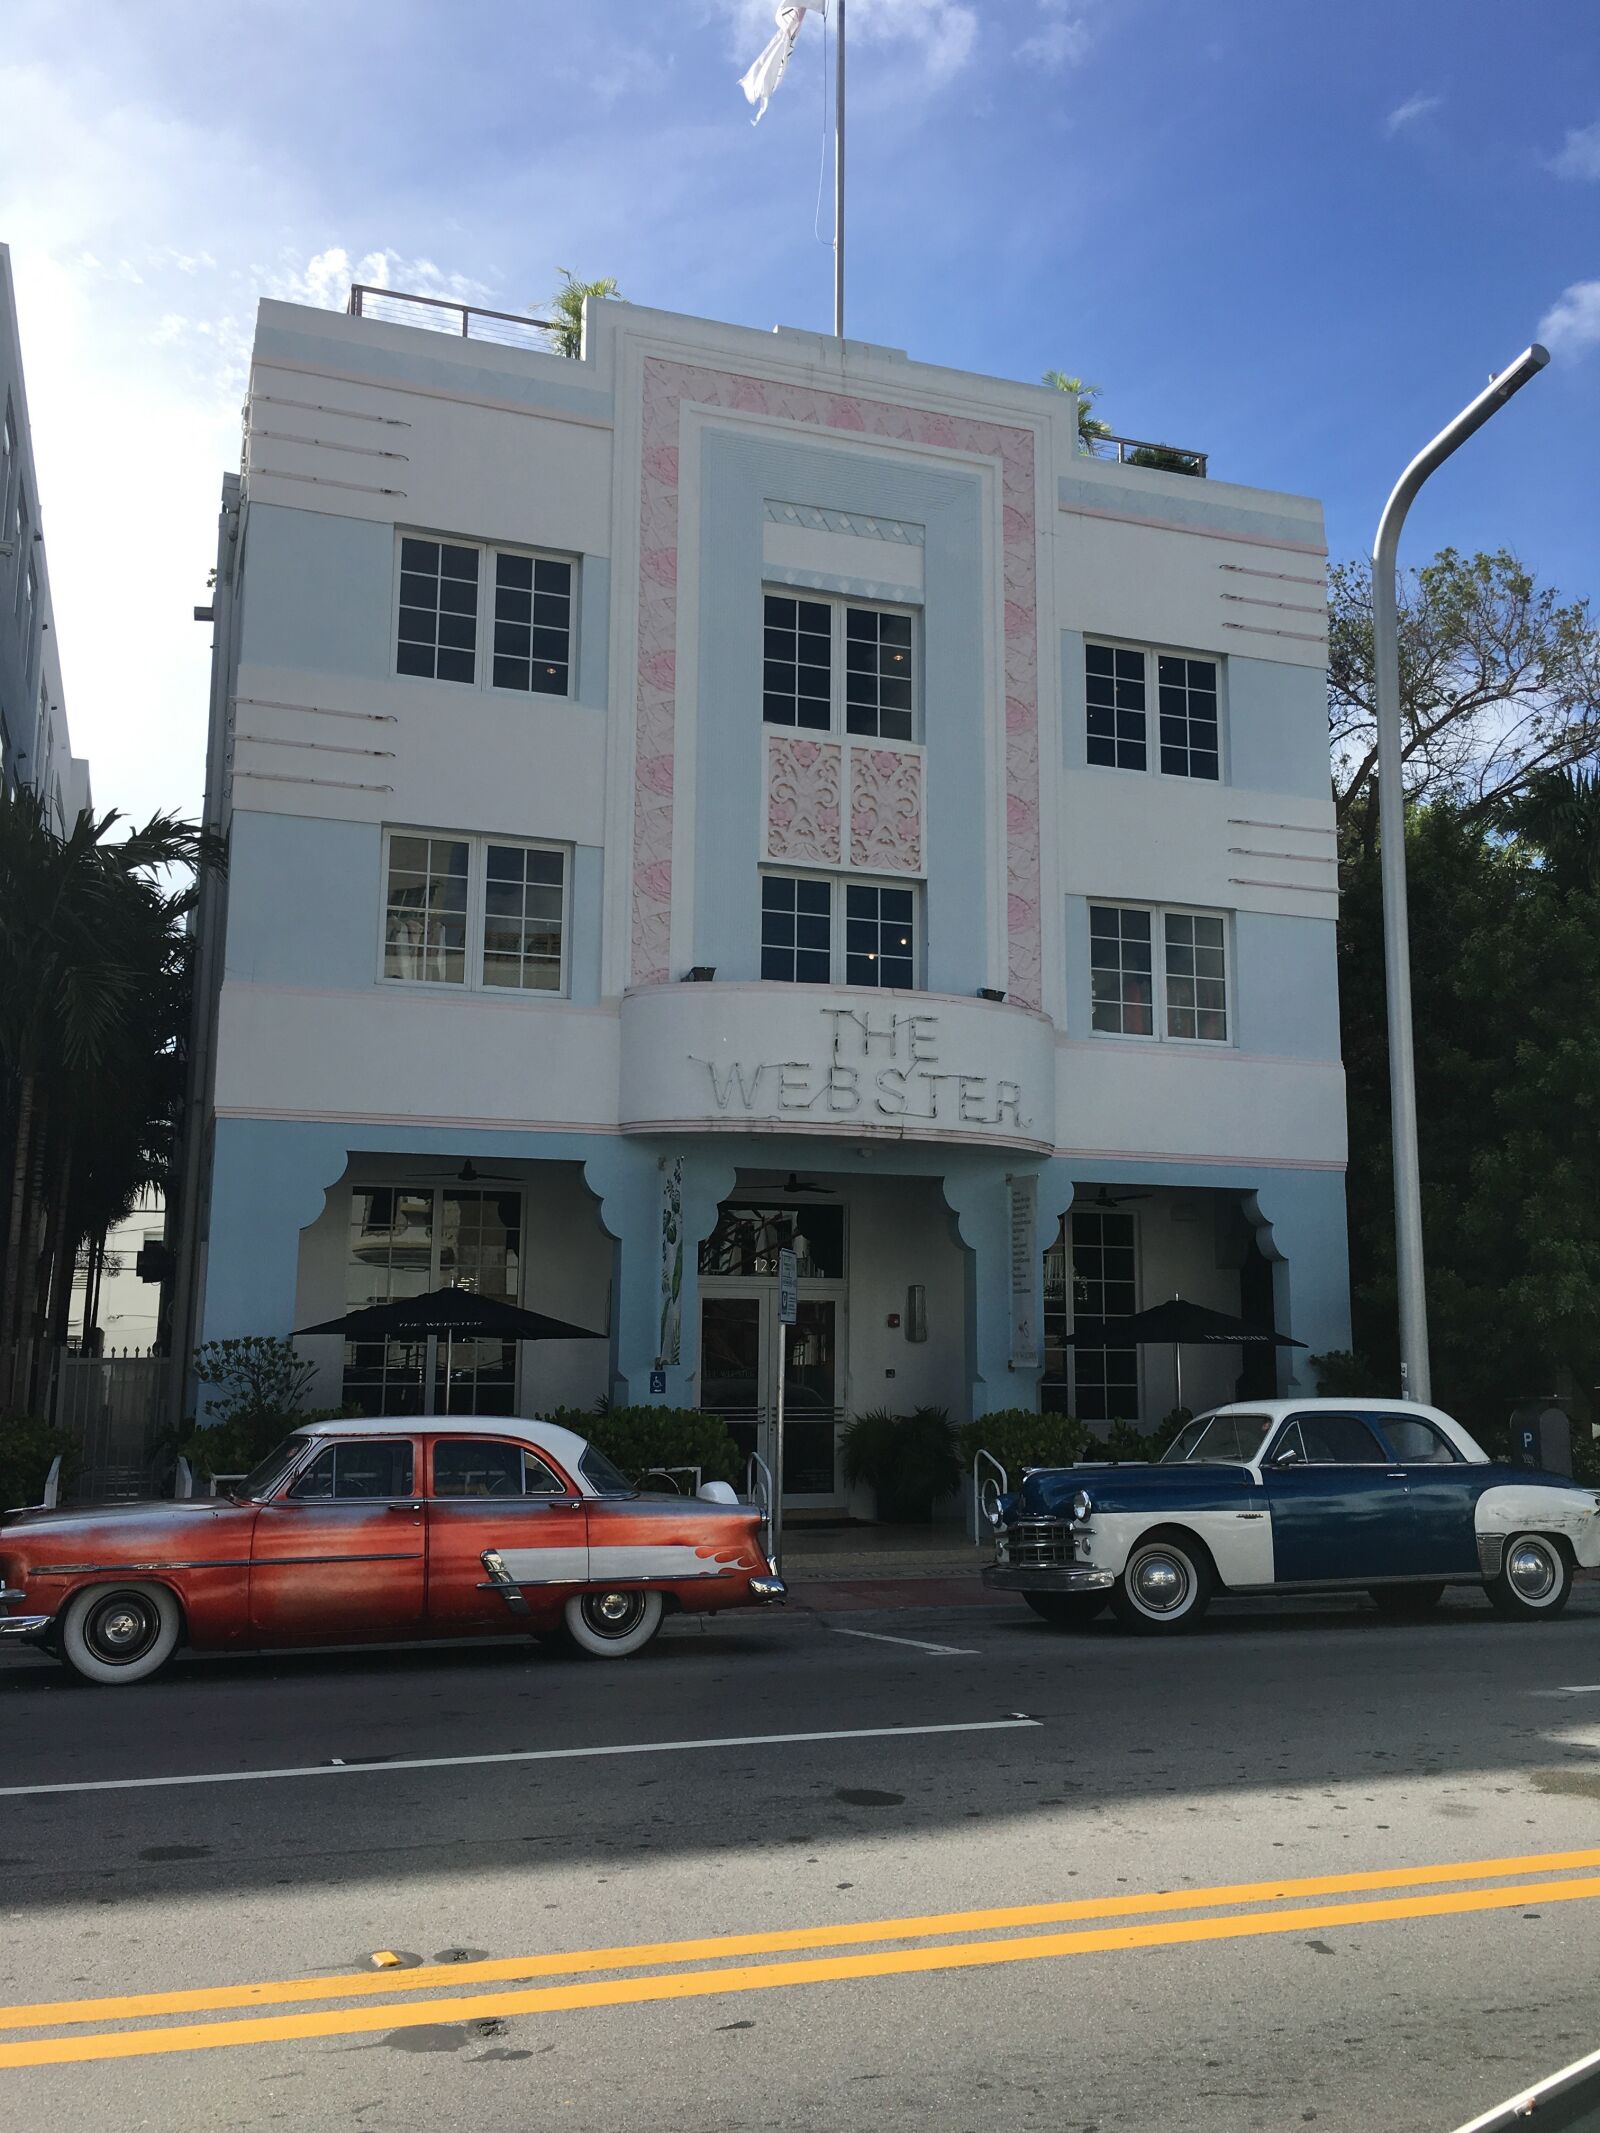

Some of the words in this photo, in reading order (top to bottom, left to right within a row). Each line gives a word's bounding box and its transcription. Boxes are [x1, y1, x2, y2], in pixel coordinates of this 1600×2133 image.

[820, 1008, 939, 1063] THE
[706, 1061, 1033, 1128] WEBSTER
[1523, 1432, 1533, 1448] P
